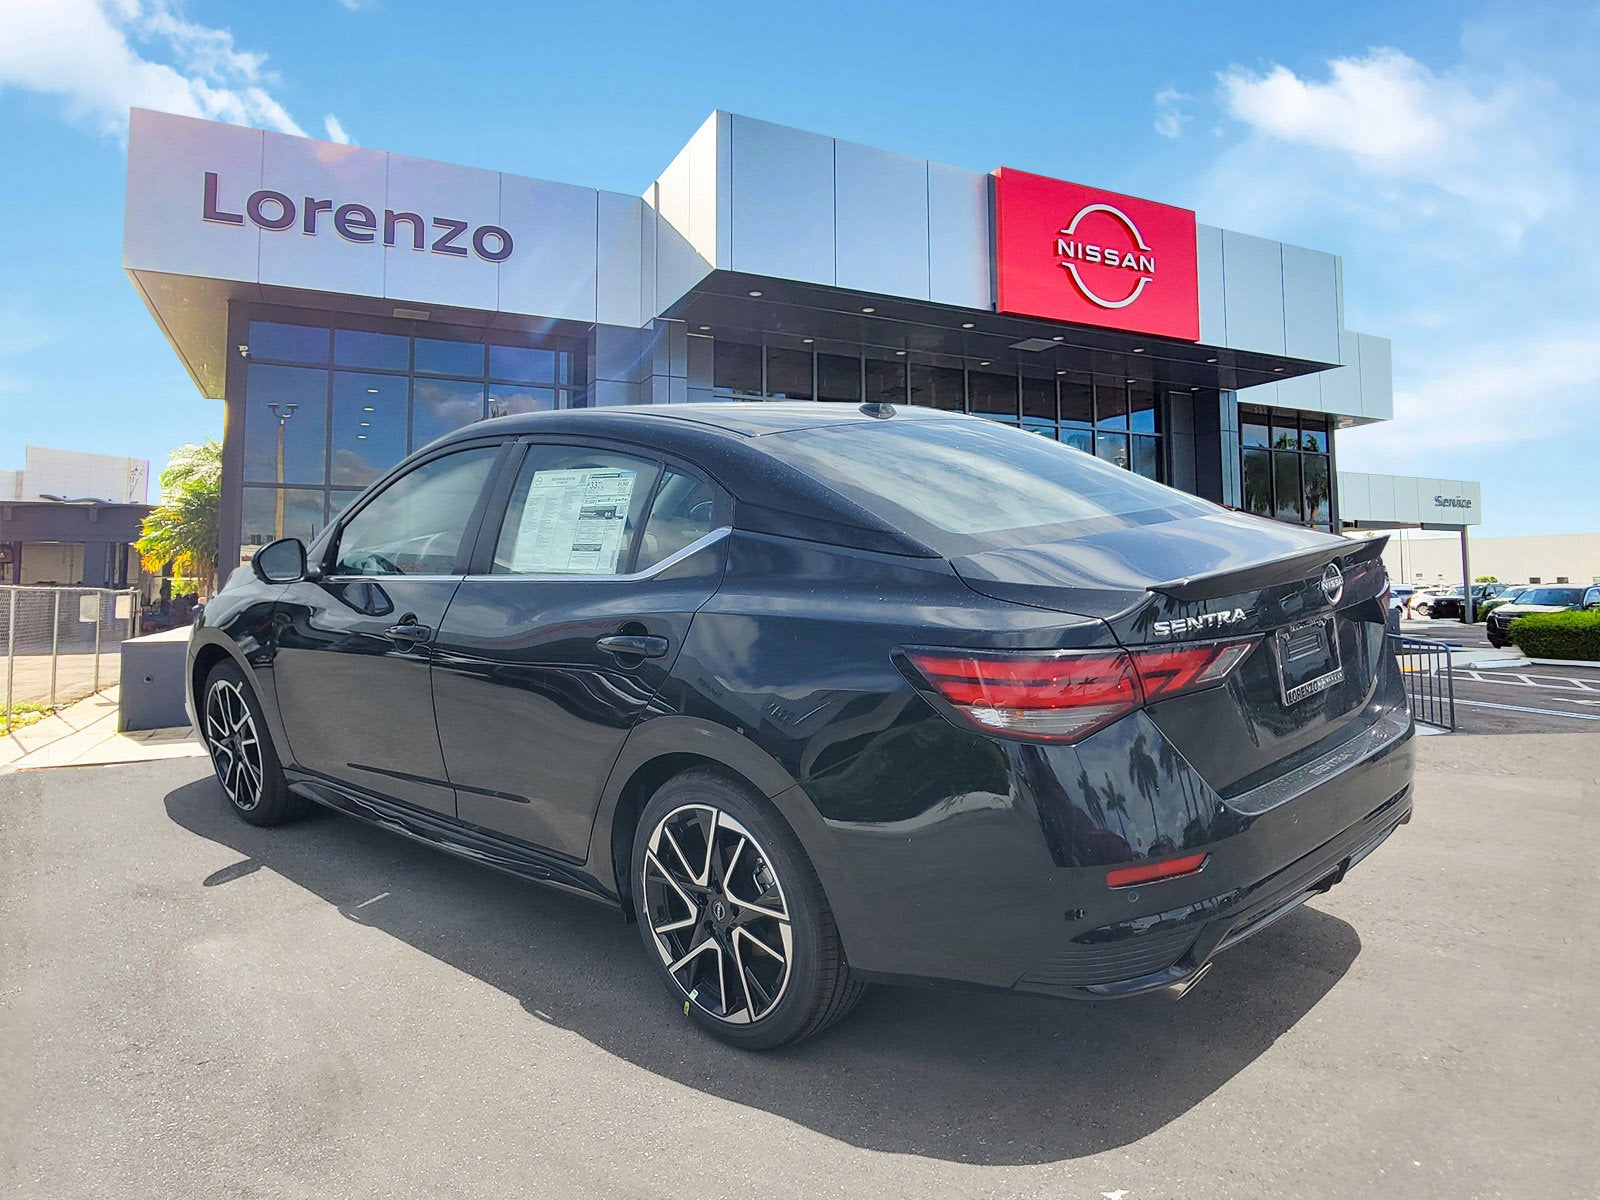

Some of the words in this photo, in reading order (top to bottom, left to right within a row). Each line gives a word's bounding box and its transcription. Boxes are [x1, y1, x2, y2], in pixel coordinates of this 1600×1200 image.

[202, 171, 514, 263] Lorenzo
[1057, 238, 1155, 273] NISSAN
[1434, 495, 1472, 509] Service
[1154, 608, 1247, 636] SENTRA
